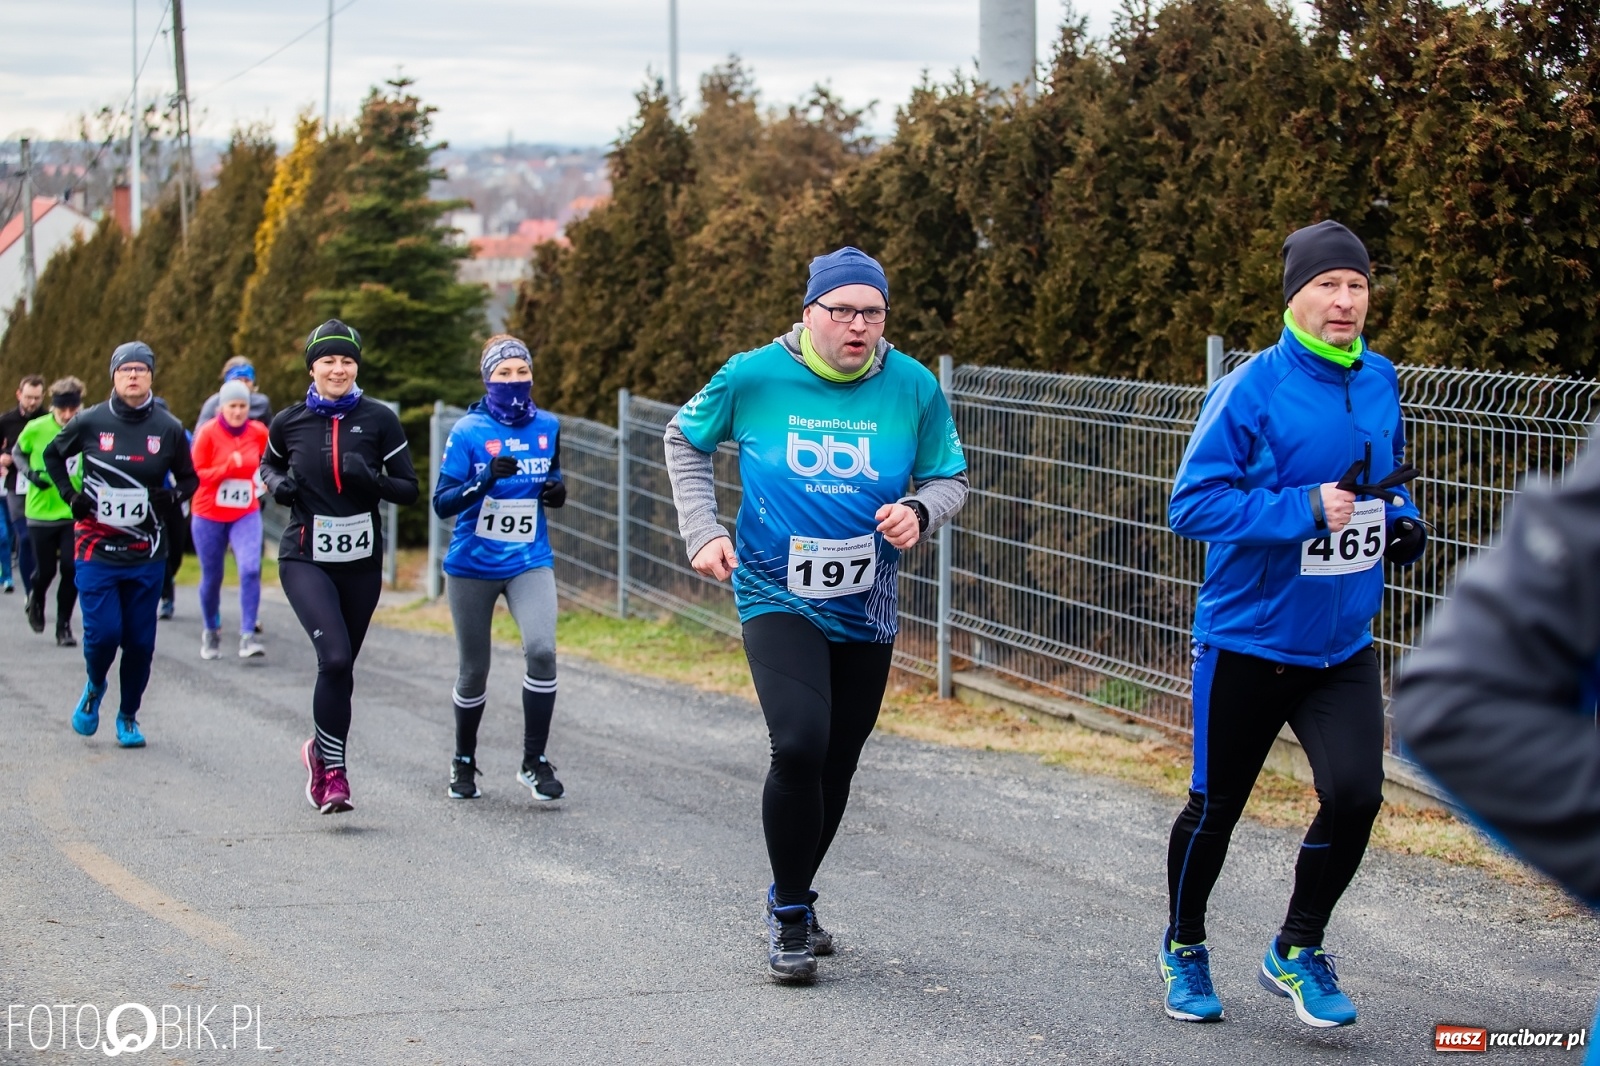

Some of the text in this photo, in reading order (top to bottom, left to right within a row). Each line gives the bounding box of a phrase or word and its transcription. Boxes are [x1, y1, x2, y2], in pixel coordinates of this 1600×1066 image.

[788, 415, 878, 432] BiegamBoLubię
[786, 432, 880, 481] bbl
[805, 483, 861, 494] RACIBÓRZ
[101, 501, 145, 518] 314
[483, 514, 533, 534] 195
[317, 530, 370, 553] 384
[822, 542, 873, 552] www.personalbest.pl
[1307, 525, 1381, 561] 465
[795, 558, 871, 587] 197
